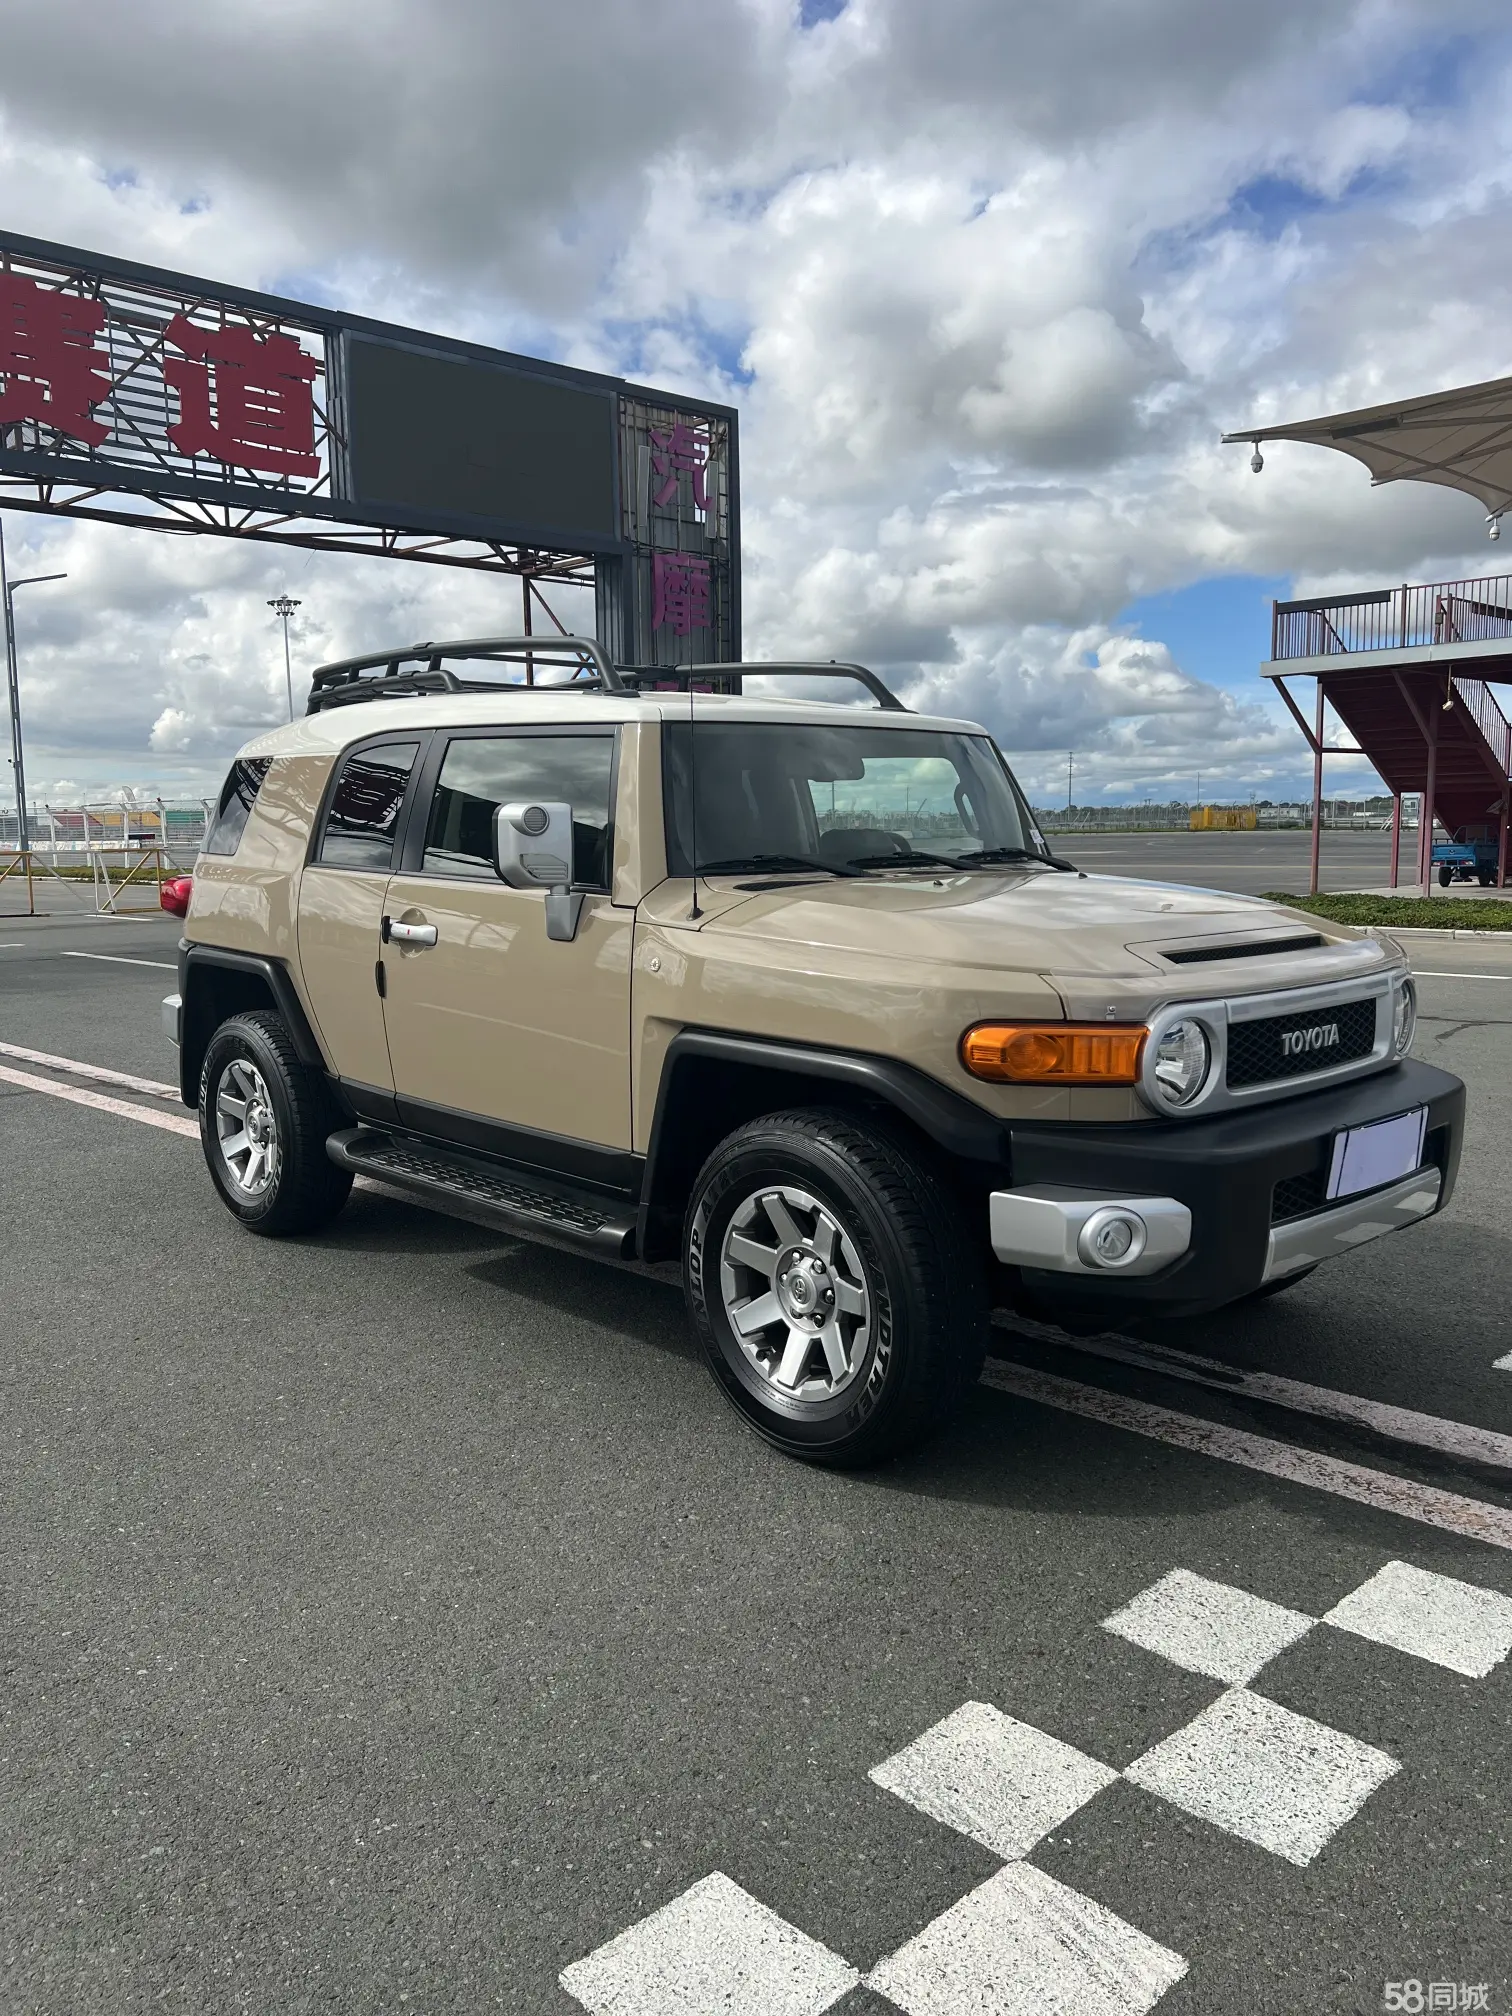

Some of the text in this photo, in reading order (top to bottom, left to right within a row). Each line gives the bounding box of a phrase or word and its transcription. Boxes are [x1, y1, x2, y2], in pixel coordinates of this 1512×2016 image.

[650, 423, 714, 693] 汽摩
[1281, 1023, 1340, 1056] TOYOTA
[689, 1228, 724, 1360] DUNLOP
